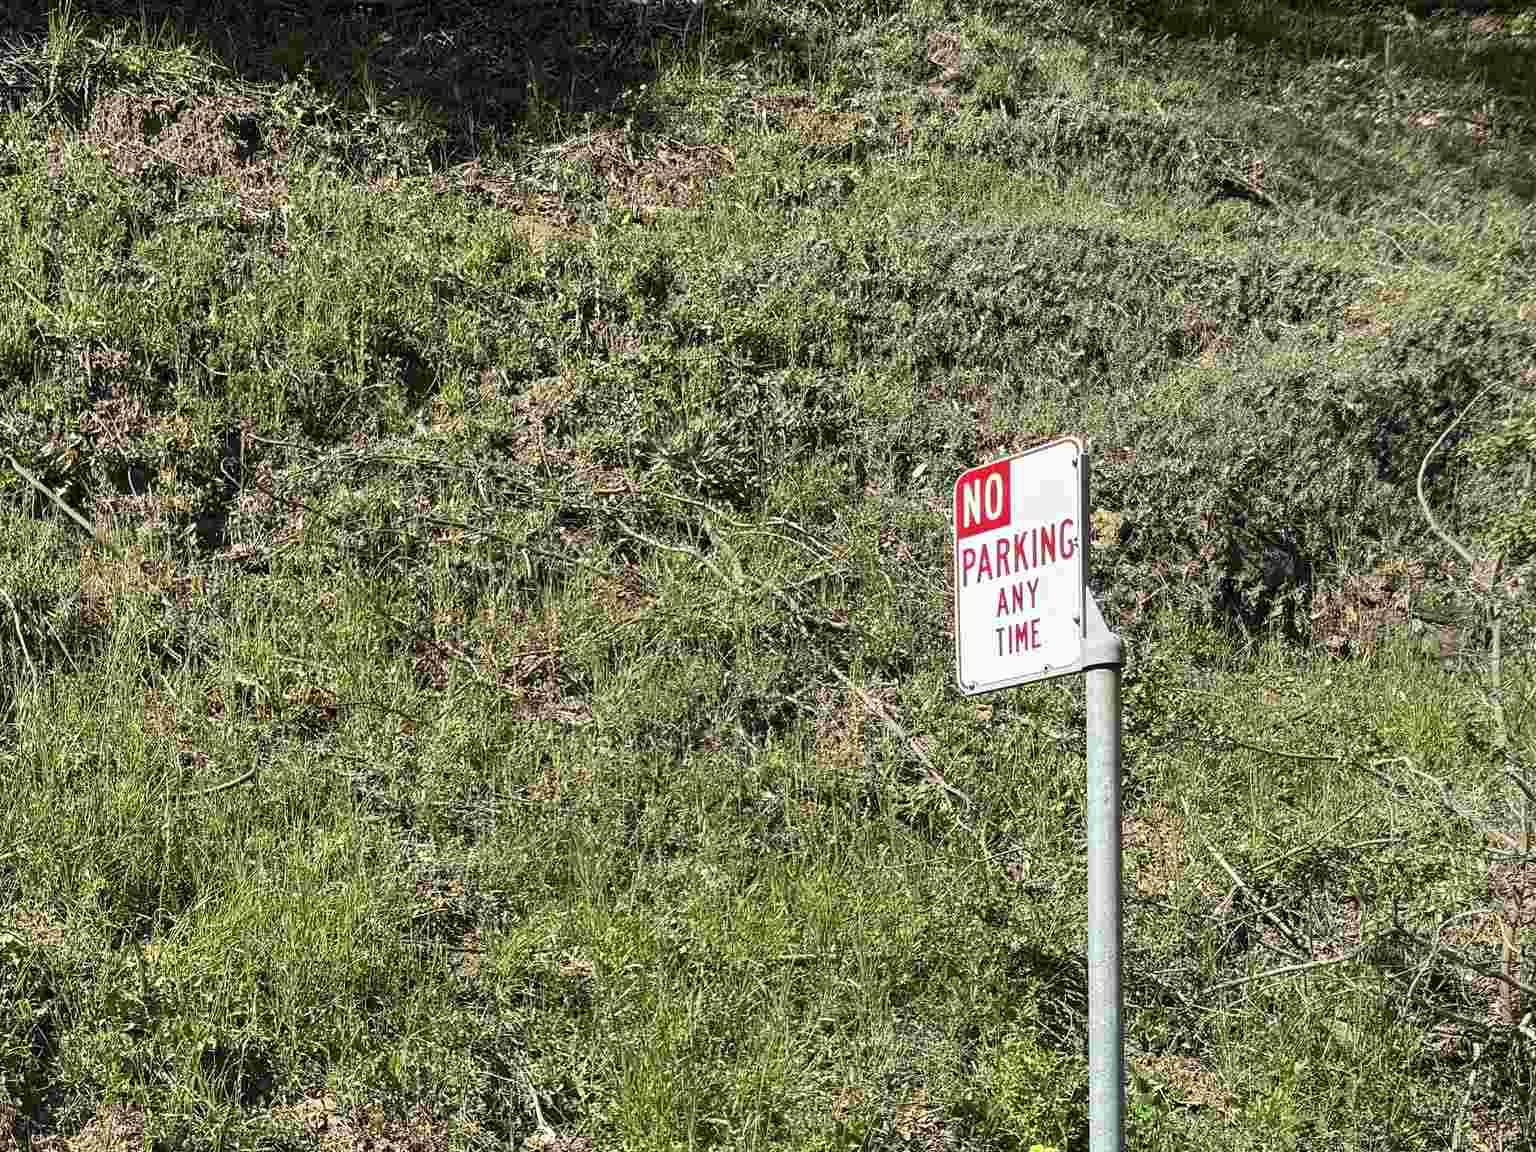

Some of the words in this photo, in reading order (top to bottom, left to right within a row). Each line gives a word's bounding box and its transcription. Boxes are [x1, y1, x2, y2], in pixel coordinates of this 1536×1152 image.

[962, 472, 1004, 529] NO
[962, 518, 1074, 587] PARKING
[996, 578, 1040, 618] ANY
[996, 618, 1041, 656] TIME
